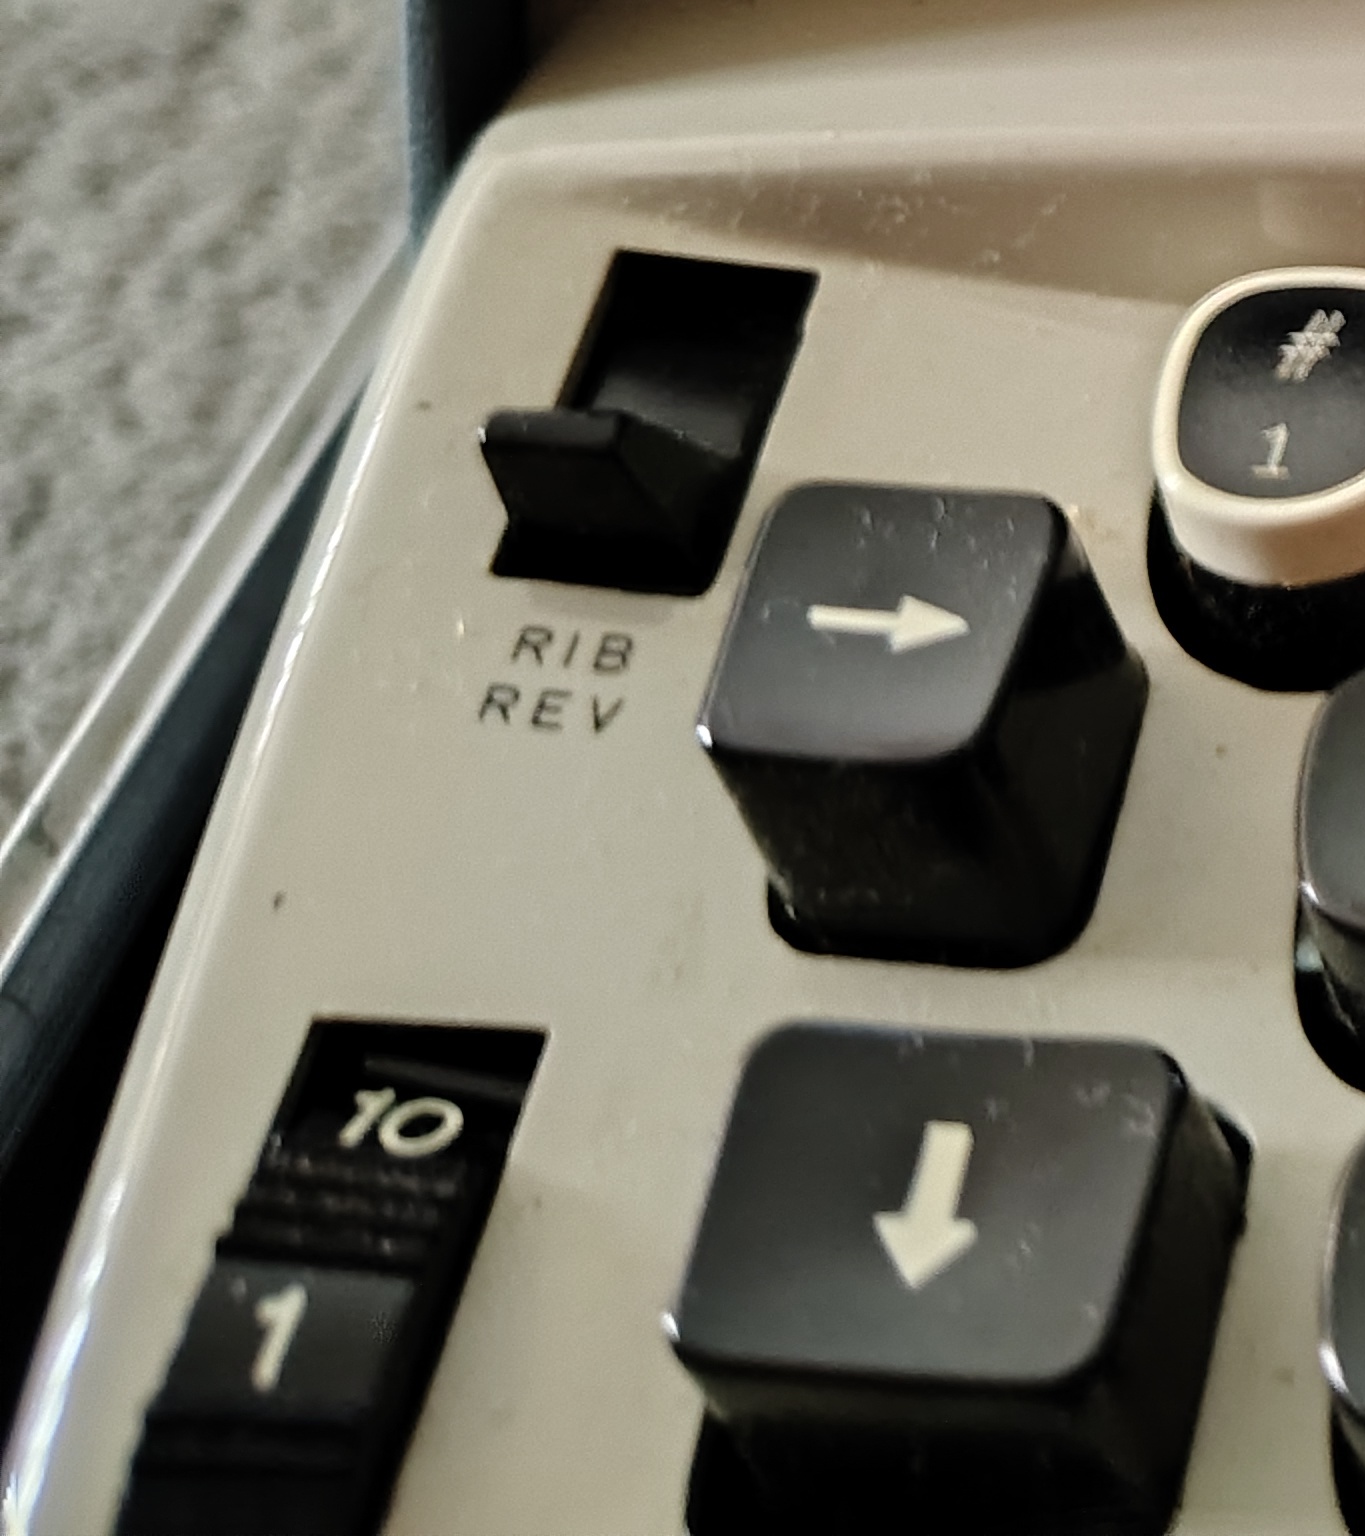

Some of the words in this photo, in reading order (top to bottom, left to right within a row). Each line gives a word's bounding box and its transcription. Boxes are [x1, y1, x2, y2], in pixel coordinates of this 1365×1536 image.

[1274, 309, 1347, 383] #
[1250, 422, 1291, 481] 1
[510, 624, 633, 675] RIB
[477, 682, 624, 734] REV
[338, 1087, 465, 1159] 10
[252, 1283, 308, 1391] 1
